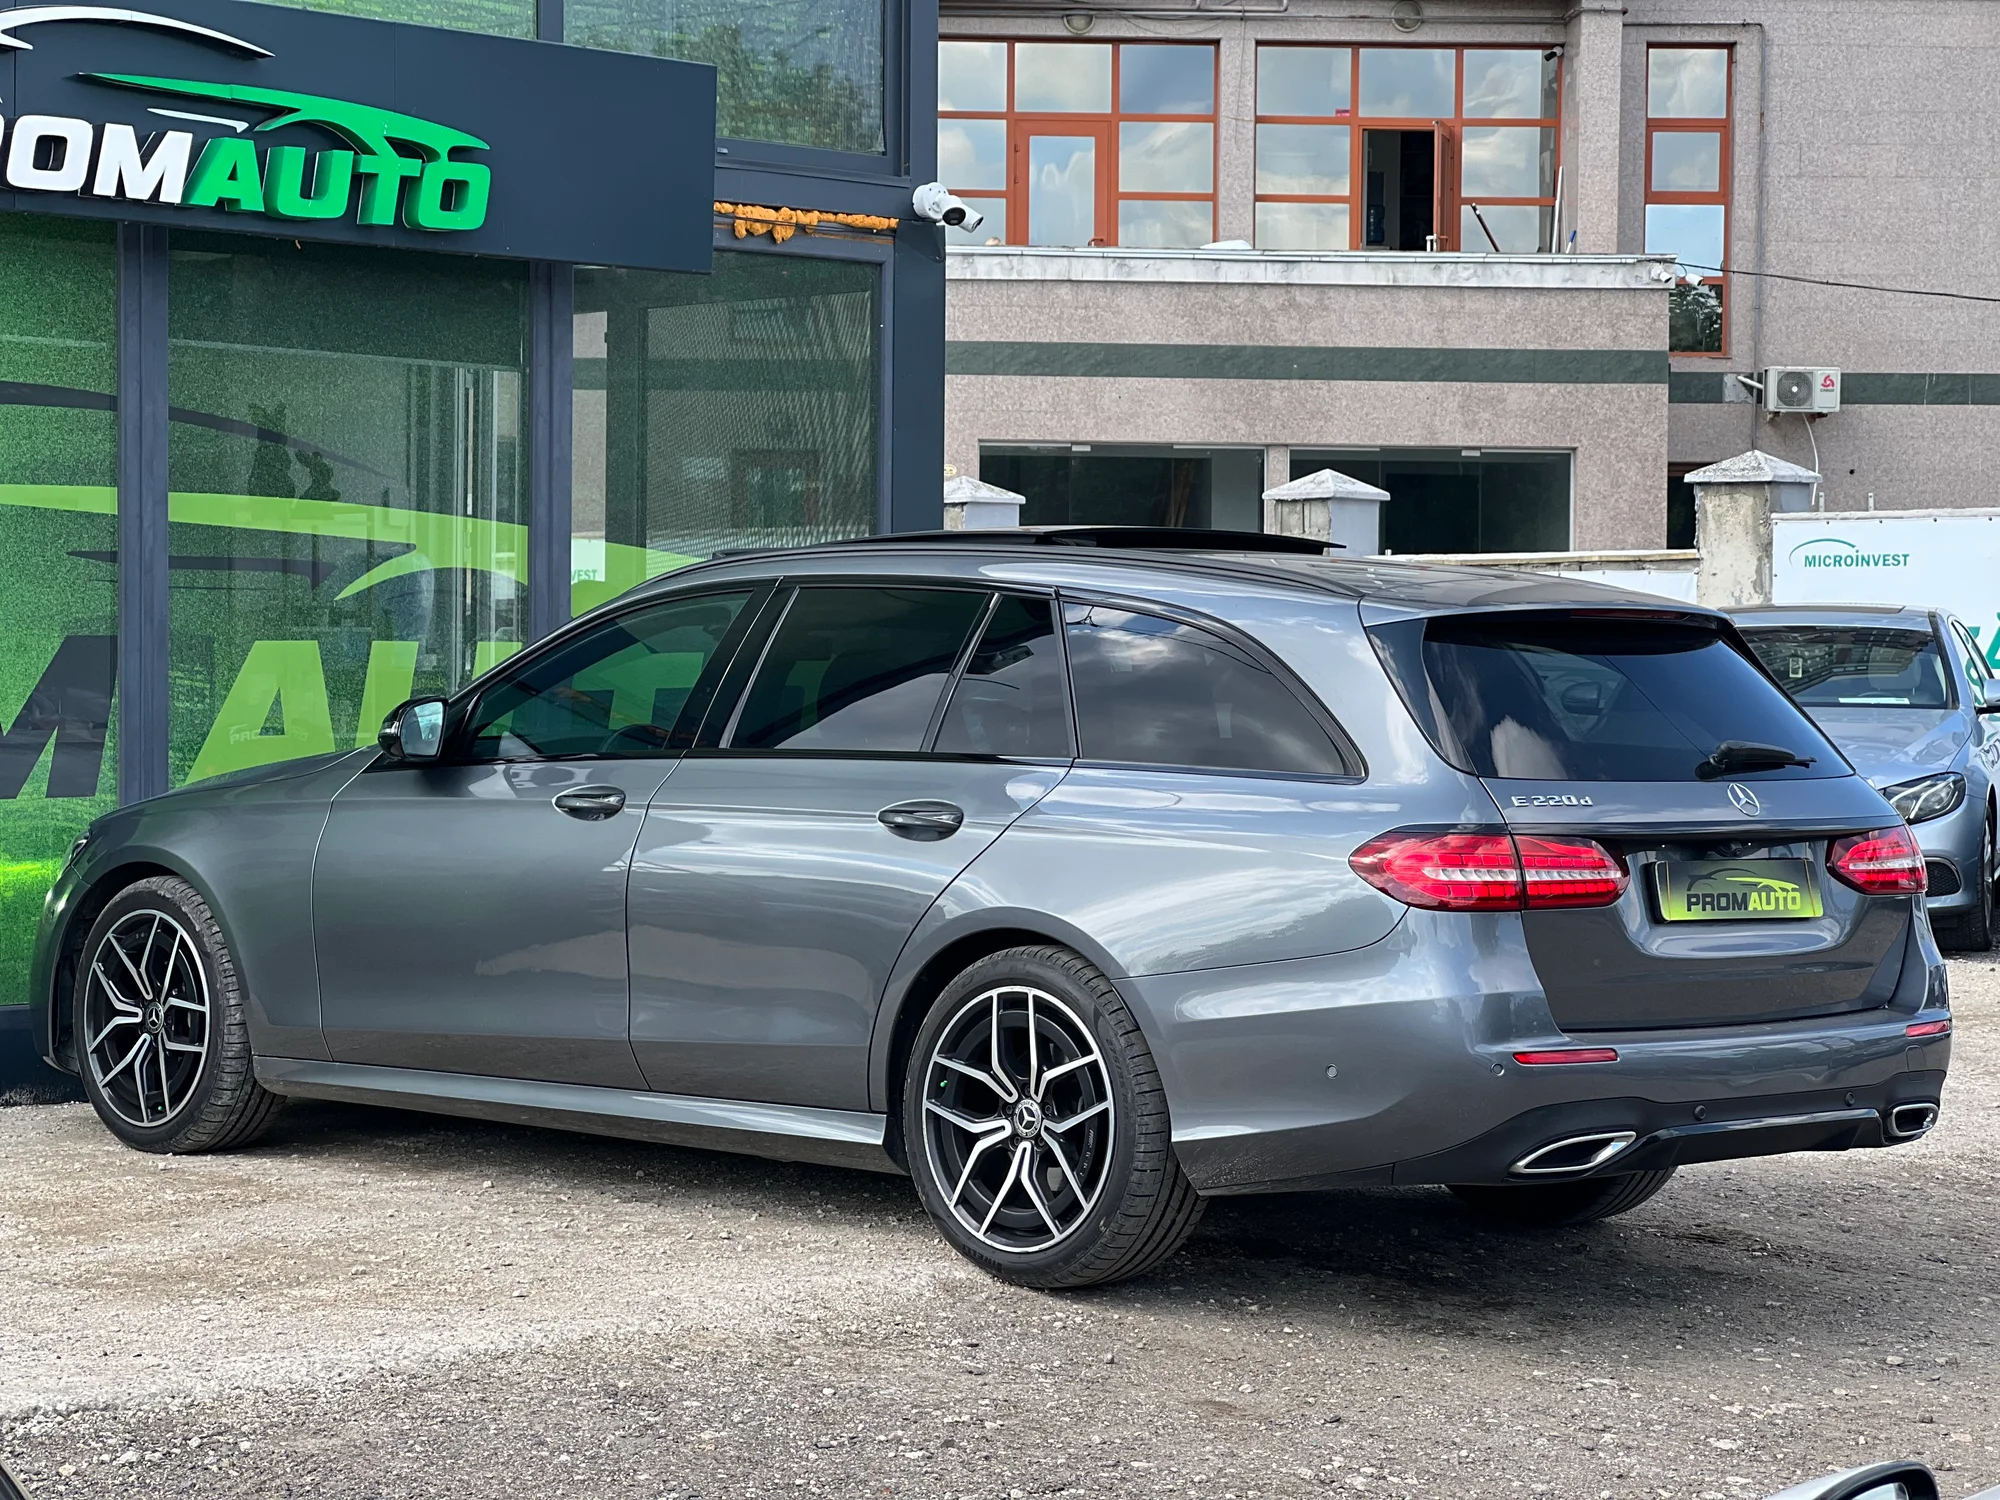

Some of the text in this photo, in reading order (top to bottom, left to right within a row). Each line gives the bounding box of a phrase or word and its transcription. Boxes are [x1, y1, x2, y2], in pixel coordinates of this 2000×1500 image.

[0, 114, 492, 231] OMAUTO
[1511, 794, 1594, 807] E 220d
[1686, 891, 1801, 912] PROMAUTO
